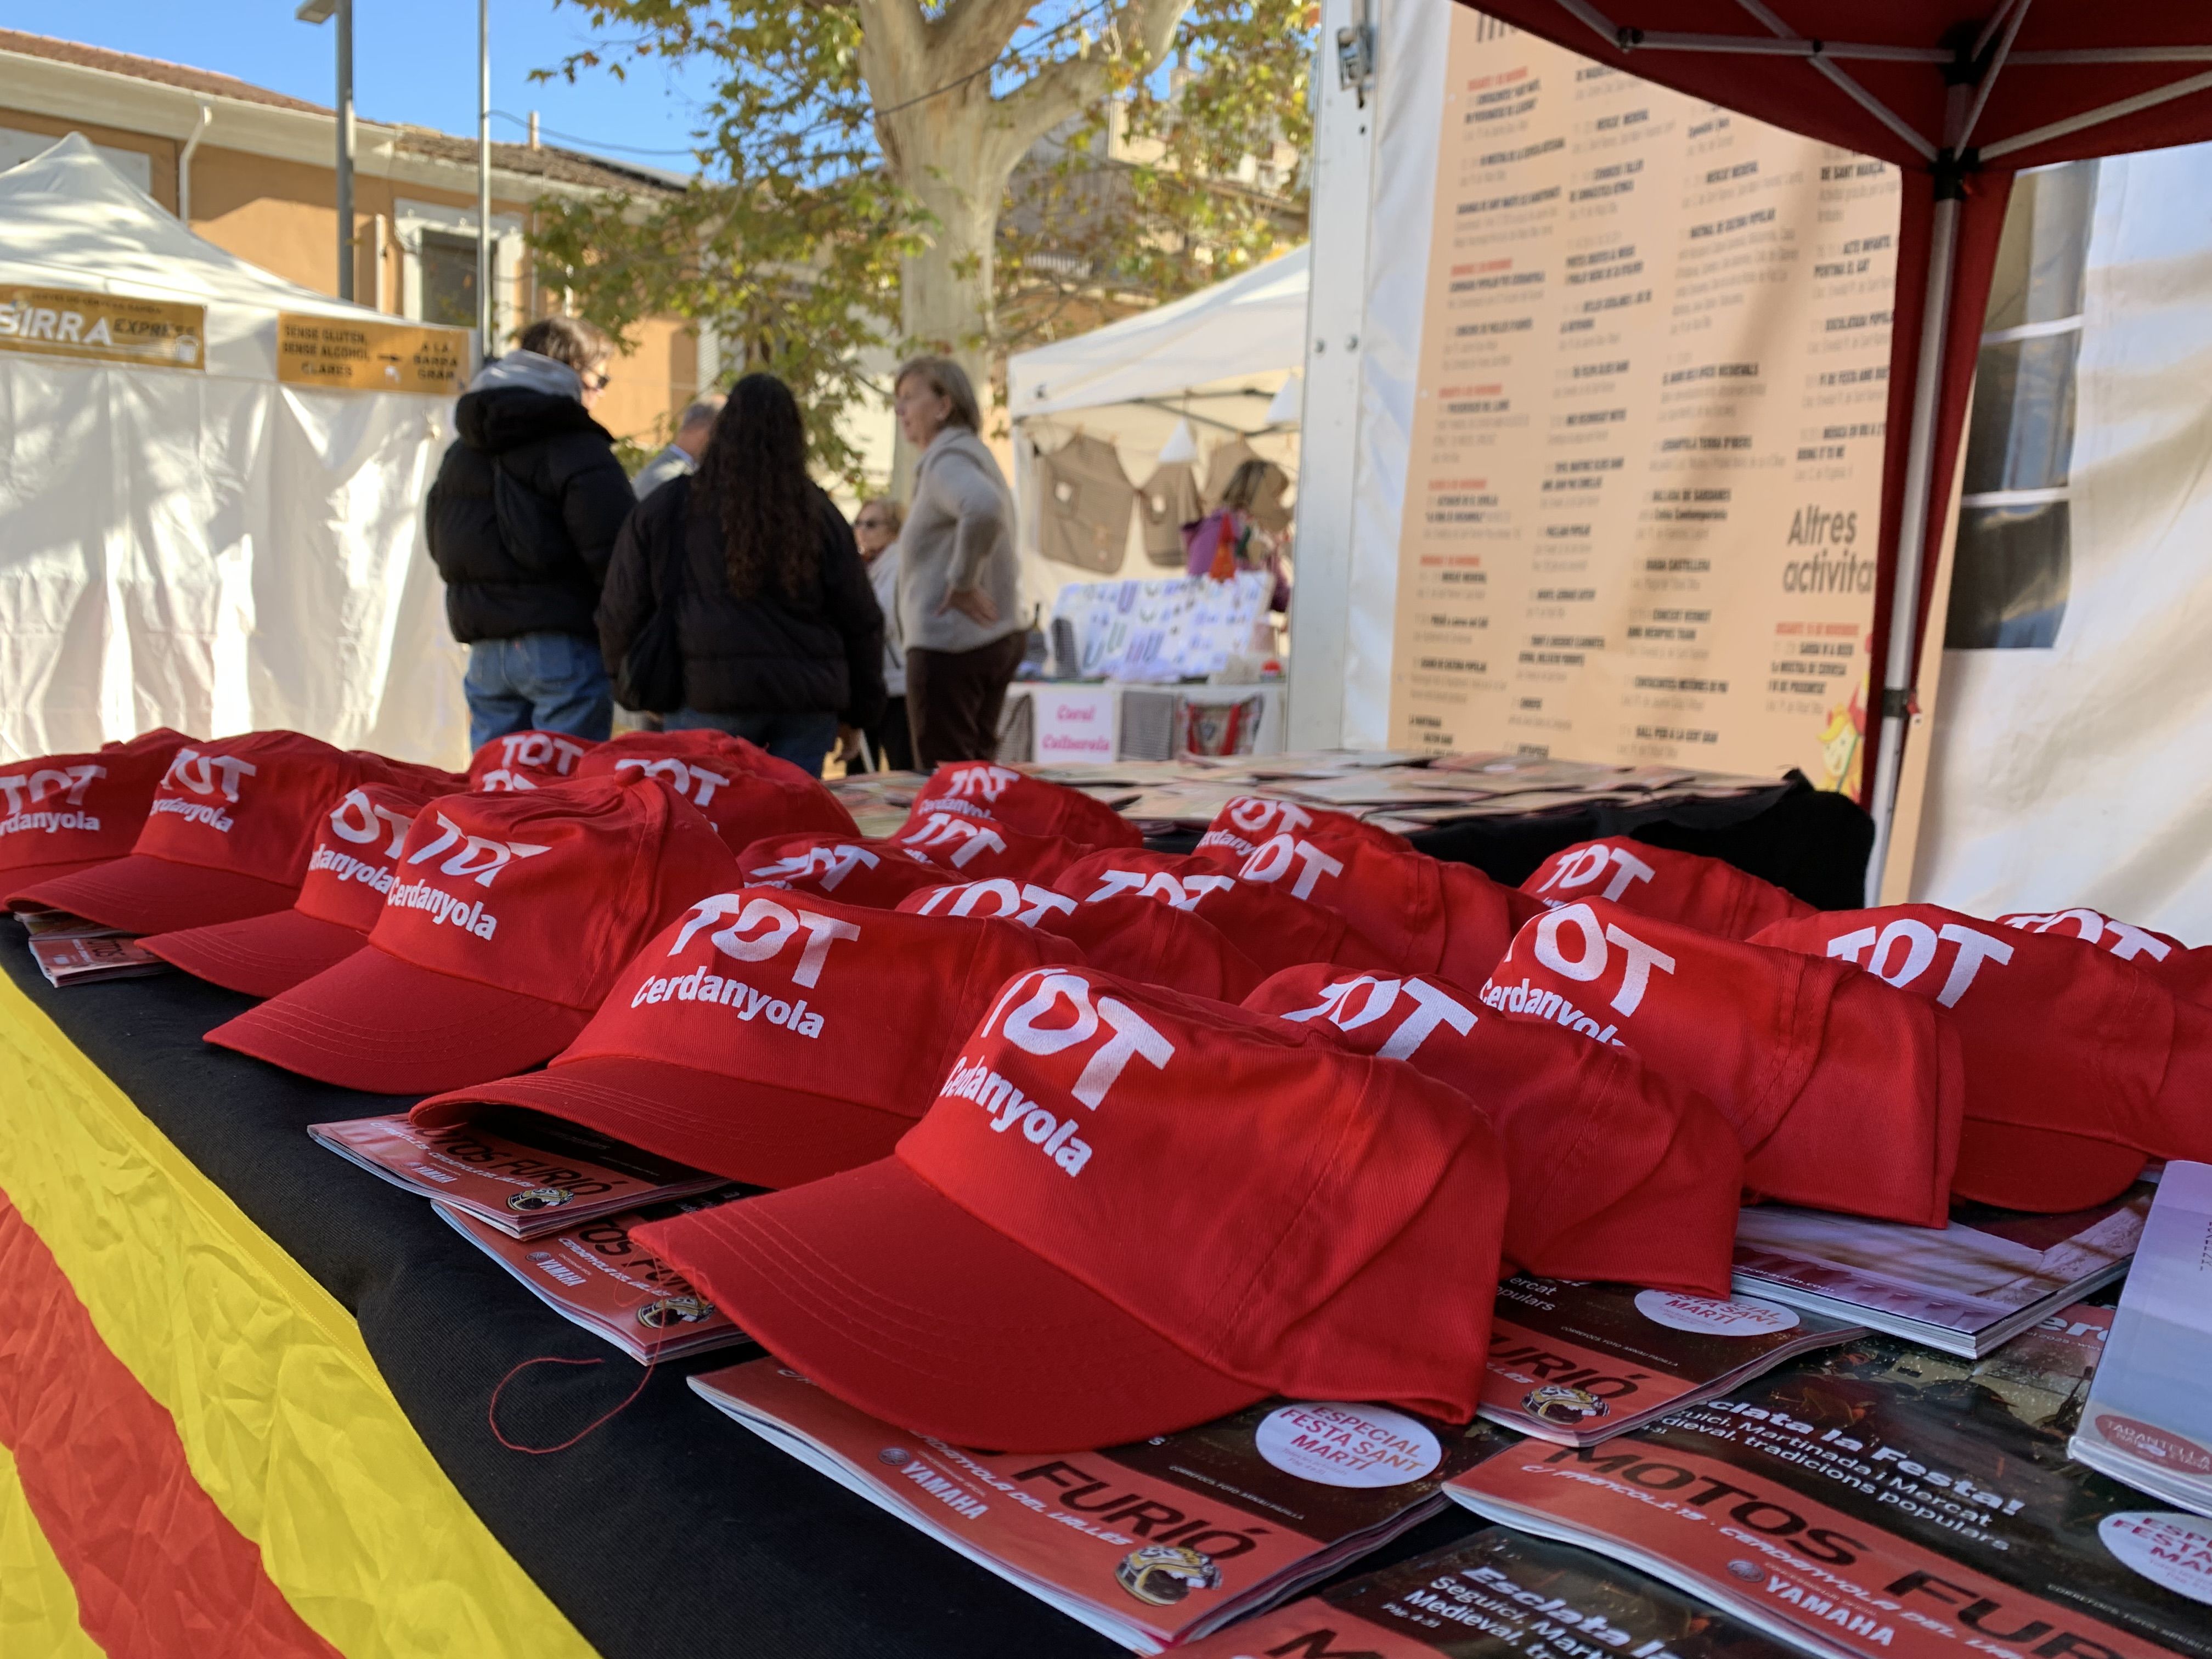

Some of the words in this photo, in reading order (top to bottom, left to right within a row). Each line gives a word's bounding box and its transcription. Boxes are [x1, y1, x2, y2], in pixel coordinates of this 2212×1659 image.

[1787, 504, 1858, 546] Altres
[501, 733, 584, 776] TOT
[329, 788, 414, 860] OT
[1537, 844, 1656, 902] TOT
[387, 876, 498, 941] Cerdanyola
[668, 893, 861, 989] TOT
[1827, 918, 2015, 1009] TOT
[631, 966, 825, 1039] Cerdanyola
[939, 1055, 1093, 1178] Cerdanyola
[411, 1166, 458, 1184] YAMAHA
[487, 1159, 628, 1197] FURIÓ
[536, 1259, 587, 1287] YAMAHA
[1510, 1277, 1557, 1296] ercat
[1489, 1333, 1651, 1398] URIÓ
[1278, 1408, 1348, 1448] FESTA
[1352, 1438, 1425, 1473] SANT
[1311, 1406, 1419, 1458] ESPECIAL
[1703, 1400, 1814, 1435] clata
[1821, 1428, 1864, 1452] la
[1870, 1446, 2025, 1516] Festa!
[900, 1460, 990, 1520] YAMAHA
[1007, 1491, 1048, 1513] DEL
[1543, 1445, 1872, 1566] MOTOS
[1661, 1416, 1736, 1441] dieval,
[1744, 1436, 1877, 1494] tradicions
[1877, 1490, 2010, 1551] populars
[1738, 1420, 1872, 1476] Martinada
[1875, 1471, 1888, 1481] i
[1889, 1477, 1993, 1528] Mercat
[1011, 1460, 1274, 1561] FURIÓ
[1429, 1576, 1525, 1624] Seguici,
[1460, 1566, 1632, 1646] Esclata
[1719, 1526, 1903, 1612] CERDANYOLA
[1900, 1611, 1957, 1639] DEL
[1764, 1575, 1896, 1647] YAMAHA
[1403, 1589, 1526, 1646] Medieval,
